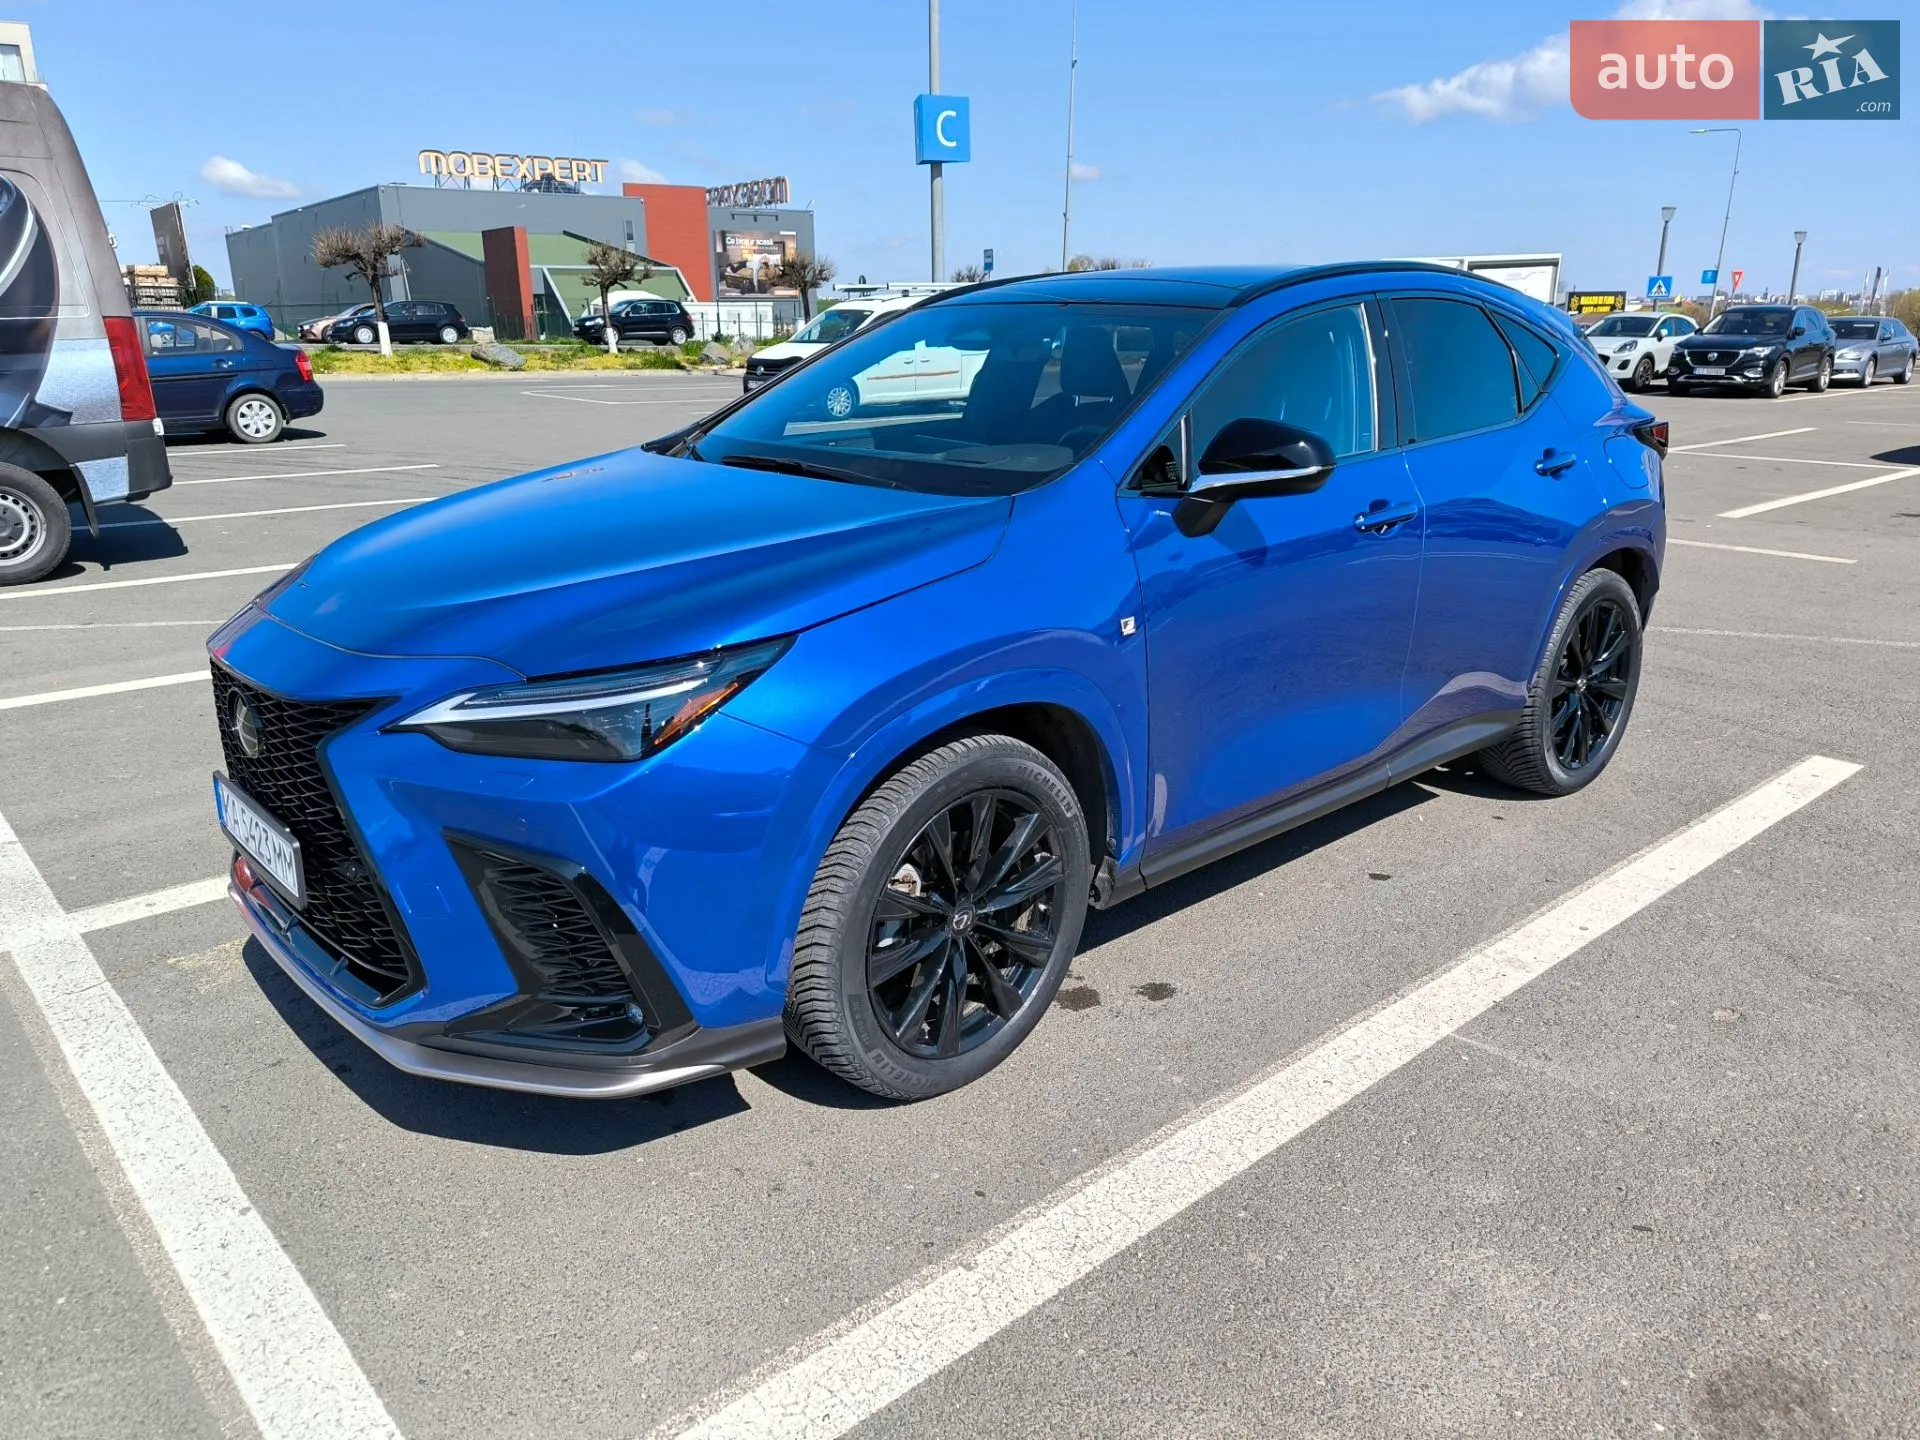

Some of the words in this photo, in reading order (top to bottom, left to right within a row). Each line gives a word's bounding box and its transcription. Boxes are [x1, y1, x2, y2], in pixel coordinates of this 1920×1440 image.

[936, 109, 957, 147] C
[418, 149, 609, 183] MOBEXPERT
[1016, 765, 1073, 814] MICHELIN
